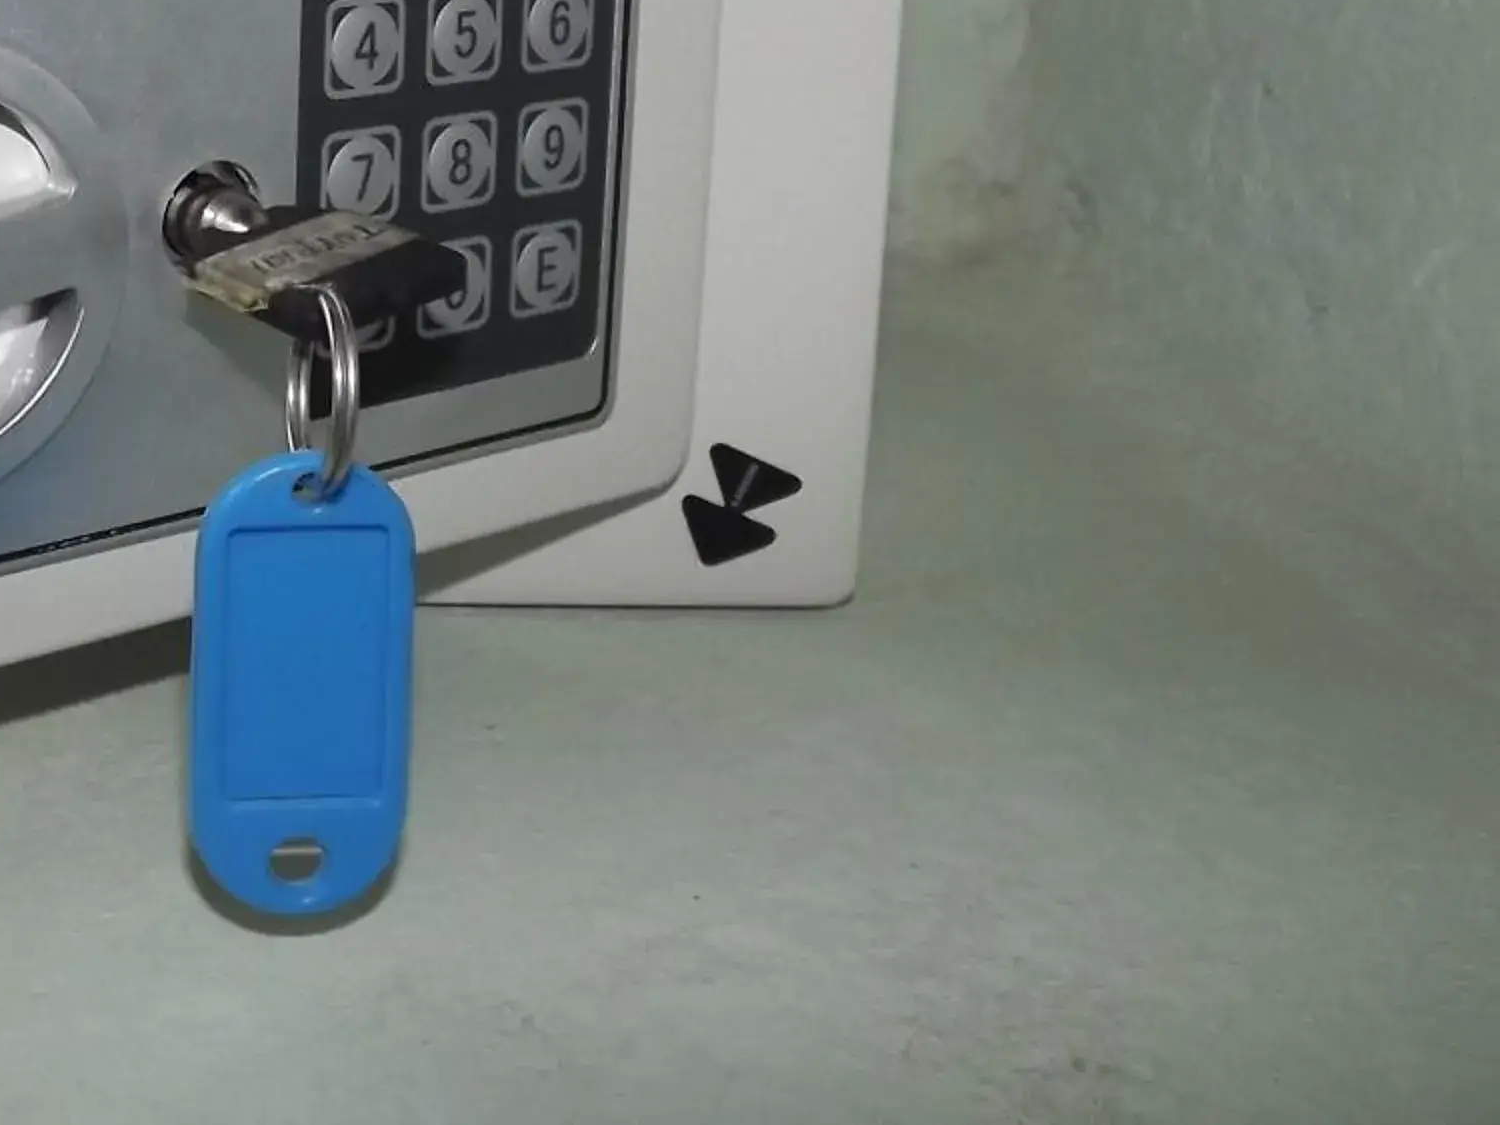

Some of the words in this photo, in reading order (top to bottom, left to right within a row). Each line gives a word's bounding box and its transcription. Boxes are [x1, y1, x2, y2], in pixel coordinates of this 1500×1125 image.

[355, 20, 379, 70] 4
[454, 9, 476, 58] 5
[549, 0, 571, 47] 6
[351, 153, 374, 201] 7
[449, 138, 472, 185] 8
[545, 124, 565, 171] 9
[536, 245, 558, 293] E
